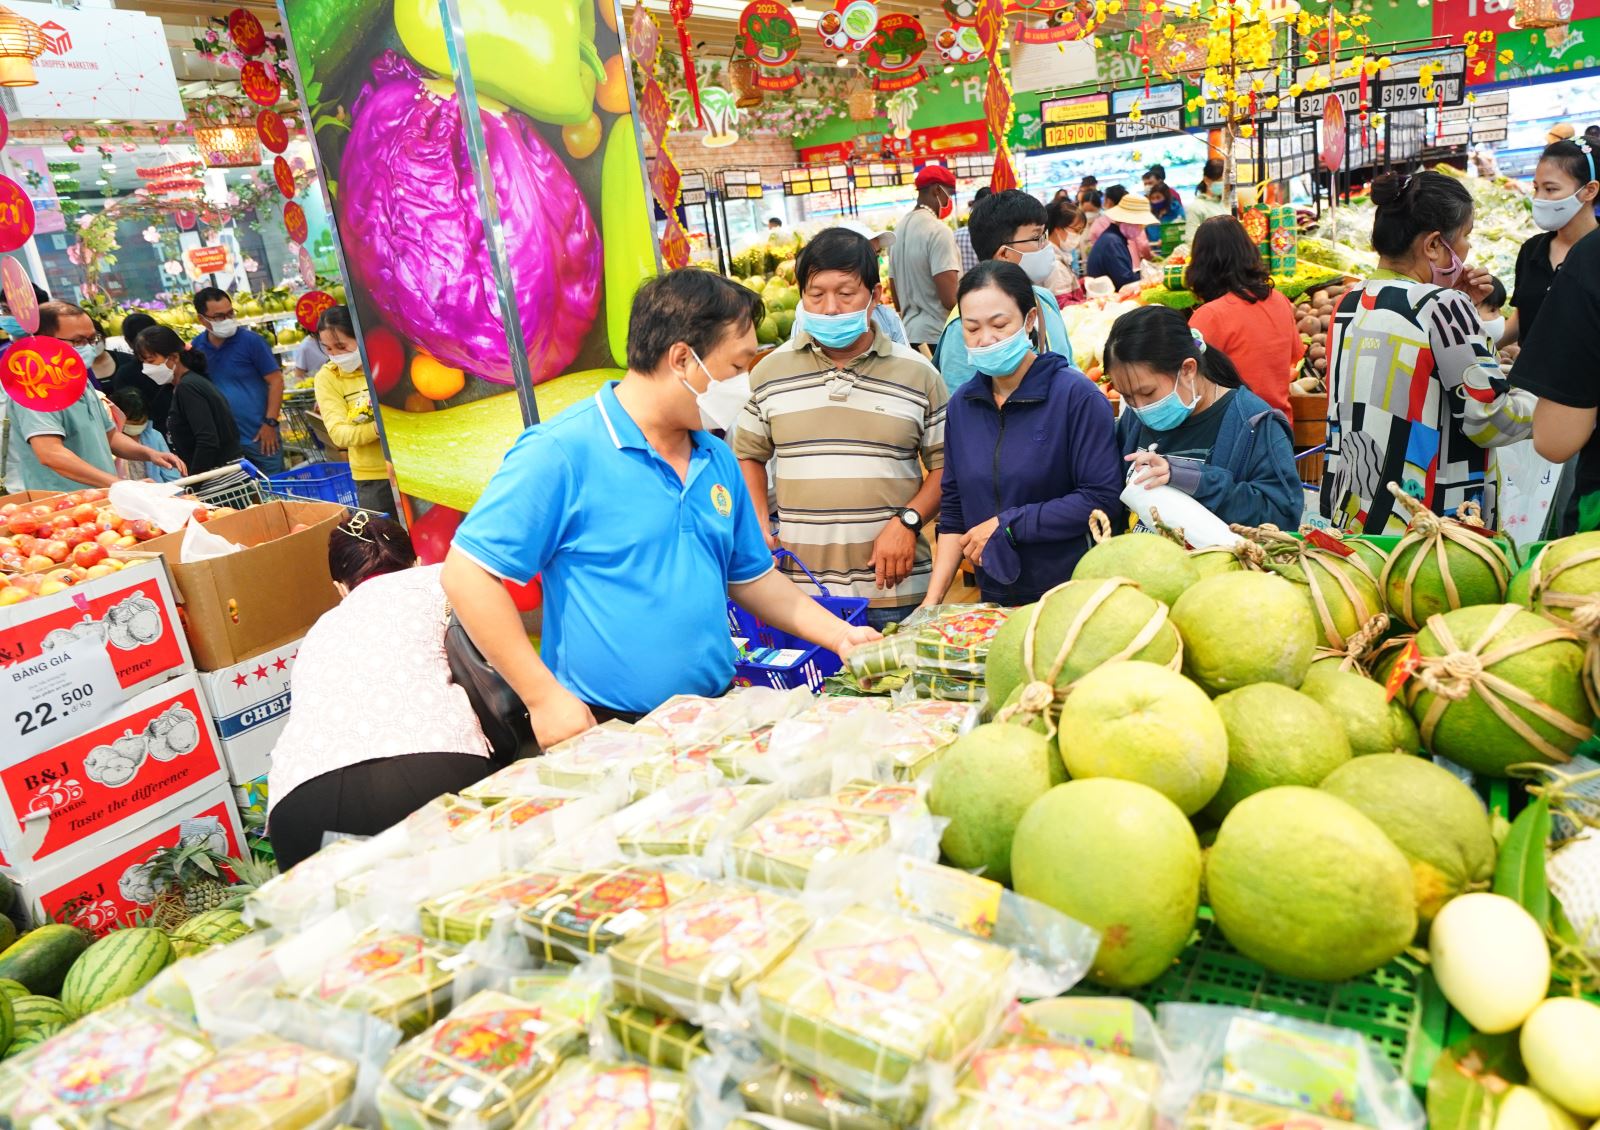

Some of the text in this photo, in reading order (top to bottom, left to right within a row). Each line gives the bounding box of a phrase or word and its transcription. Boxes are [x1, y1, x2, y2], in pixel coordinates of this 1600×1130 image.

[756, 4, 777, 14] 2023
[881, 17, 903, 28] 2023
[41, 60, 66, 68] SHOPPER
[68, 61, 99, 70] MARKETING
[69, 768, 189, 831] Taste the difference
